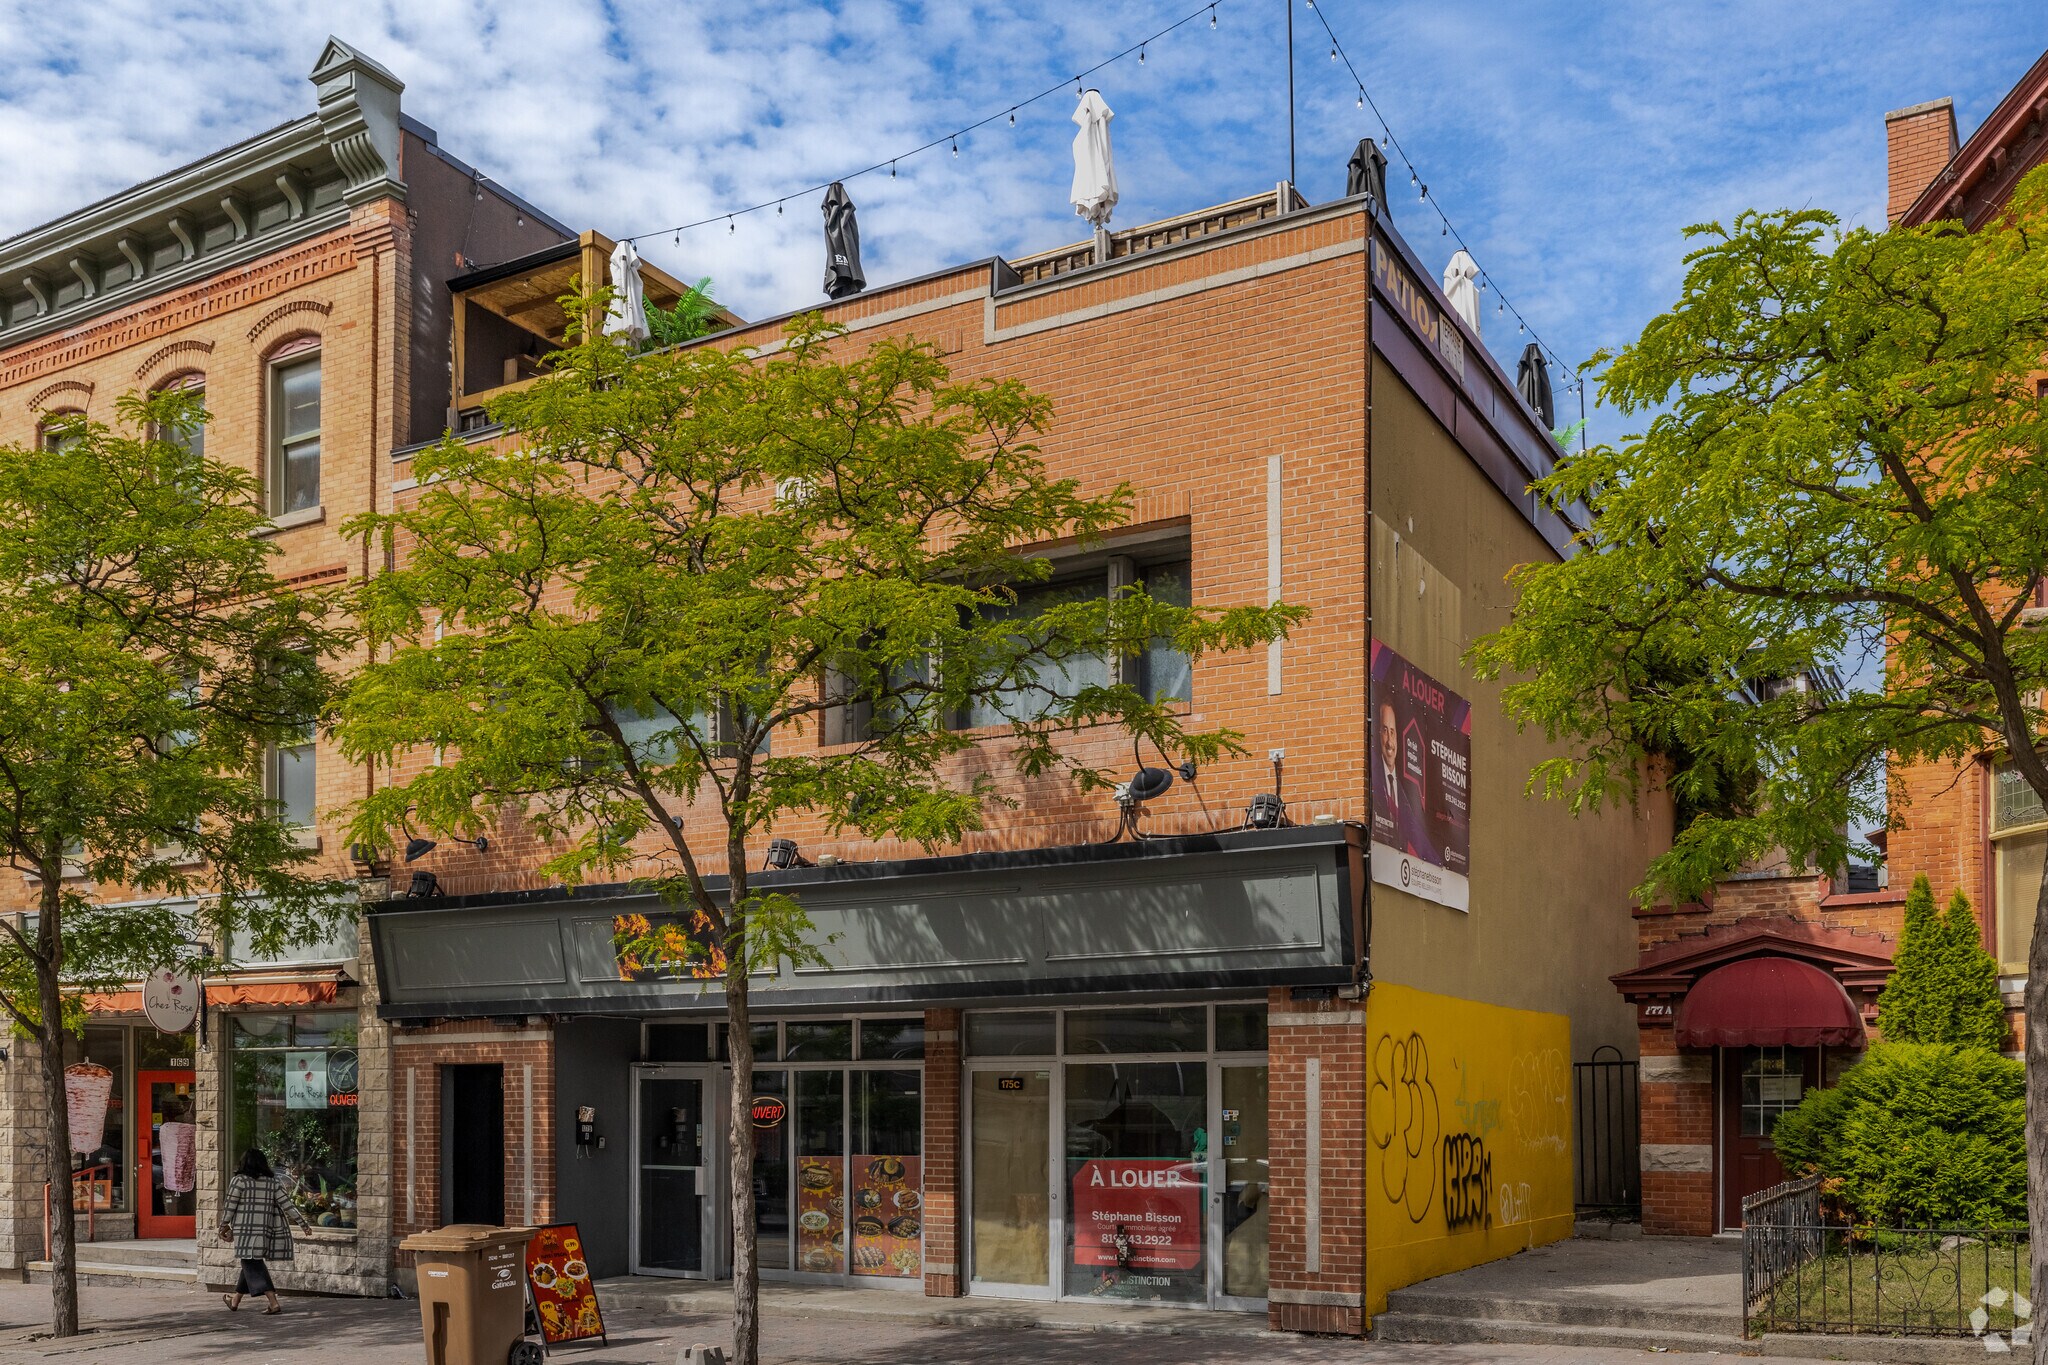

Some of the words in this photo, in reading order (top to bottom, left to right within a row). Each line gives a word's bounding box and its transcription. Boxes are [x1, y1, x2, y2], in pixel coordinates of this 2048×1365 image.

[1375, 239, 1430, 335] PATIO
[1411, 674, 1445, 714] LOUER
[1431, 739, 1467, 772] STÉPHANE
[1441, 763, 1466, 790] BISSON
[149, 996, 170, 1010] Chez
[172, 999, 194, 1012] Rose
[1645, 1005, 1664, 1015] 177
[1665, 1005, 1673, 1015] A
[170, 1058, 190, 1067] 169
[1001, 1079, 1021, 1089] 175C
[289, 1085, 306, 1099] Chez
[306, 1086, 323, 1099] Rose
[329, 1094, 359, 1107] OUVER
[752, 1105, 783, 1119] UVERT
[1090, 1165, 1105, 1187] À
[1111, 1170, 1181, 1189] LOUER
[1092, 1210, 1143, 1223] Stéphane
[1145, 1212, 1182, 1223] Bisson
[491, 1280, 517, 1290] Gatineau
